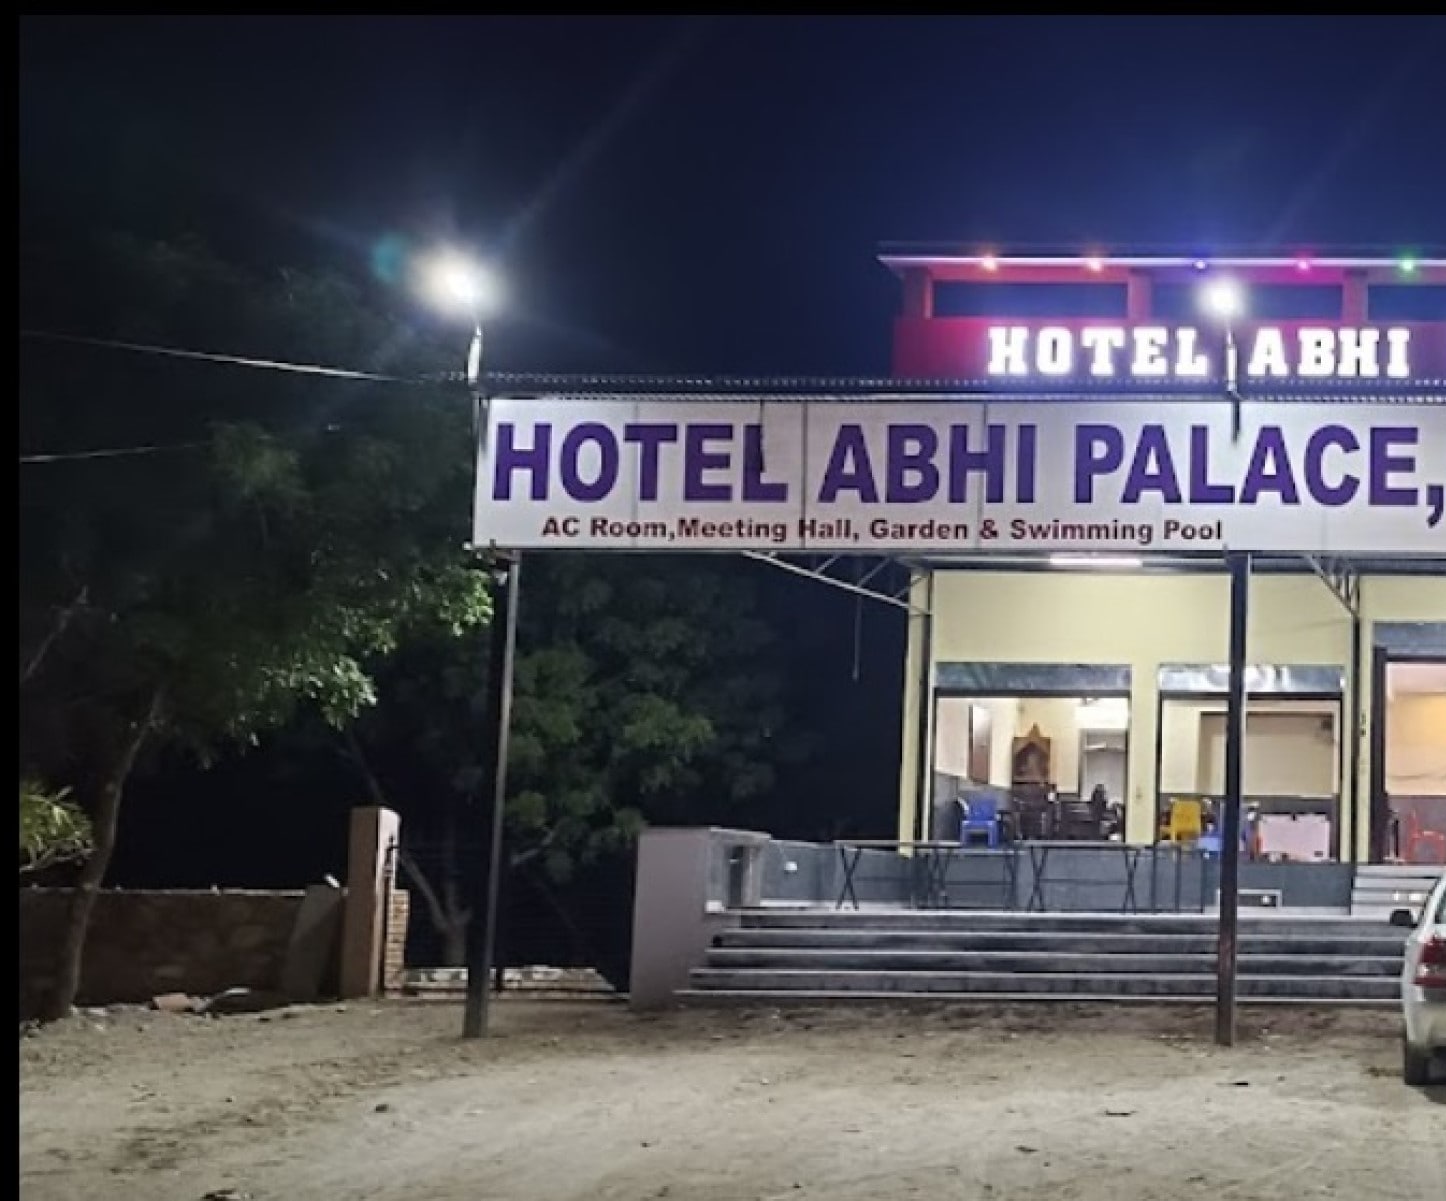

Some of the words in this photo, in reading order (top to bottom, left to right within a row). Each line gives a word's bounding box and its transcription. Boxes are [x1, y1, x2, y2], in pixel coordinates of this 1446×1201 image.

[987, 325, 1210, 377] HOTEL
[1247, 325, 1411, 378] ABHI
[493, 422, 788, 503] HOTEL
[818, 423, 1036, 504] ABHI
[542, 516, 580, 539] AC
[800, 517, 861, 541] Hall,
[870, 518, 968, 540] Garden
[980, 518, 998, 540] &
[1010, 519, 1153, 544] Swimming
[1163, 520, 1221, 540] Pool
